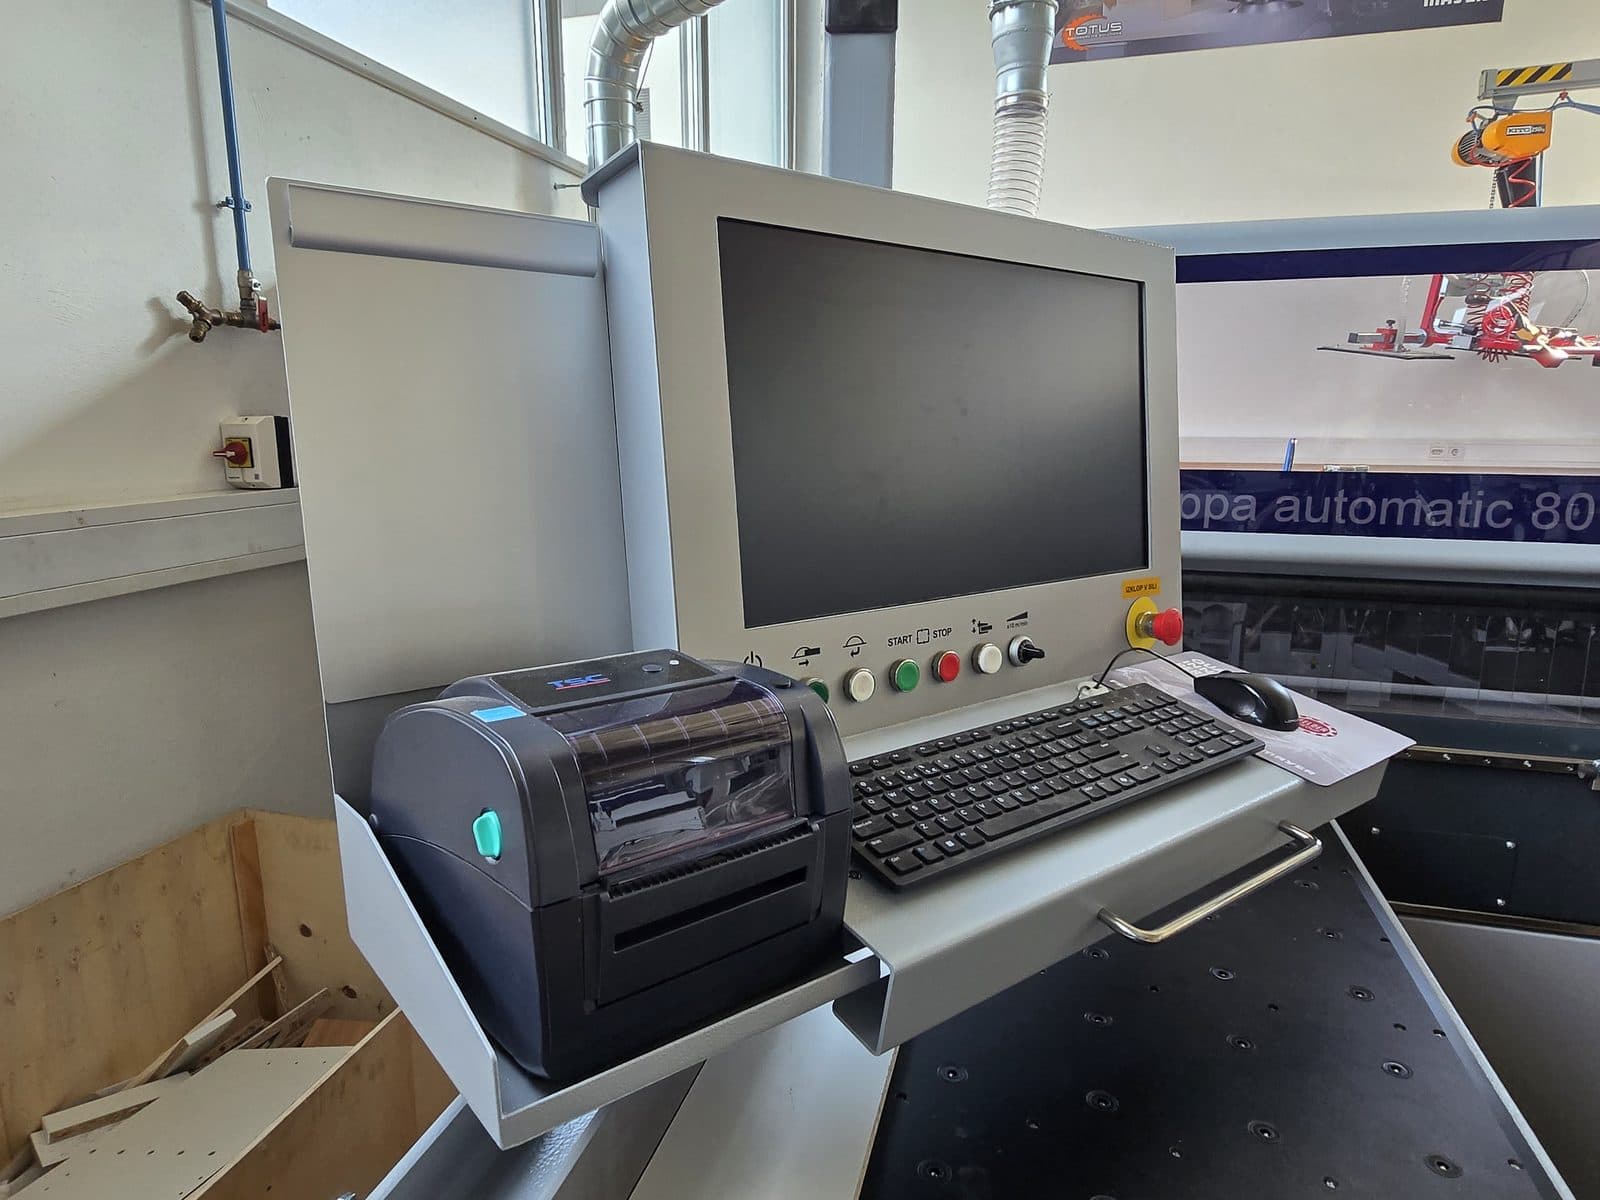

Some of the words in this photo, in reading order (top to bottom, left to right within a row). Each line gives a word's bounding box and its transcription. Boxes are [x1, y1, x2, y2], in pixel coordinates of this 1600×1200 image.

[1065, 22, 1122, 37] TOTUS
[1274, 489, 1513, 529] automatic
[1531, 491, 1594, 531] 80
[887, 634, 913, 647] START
[932, 627, 952, 639] STOP
